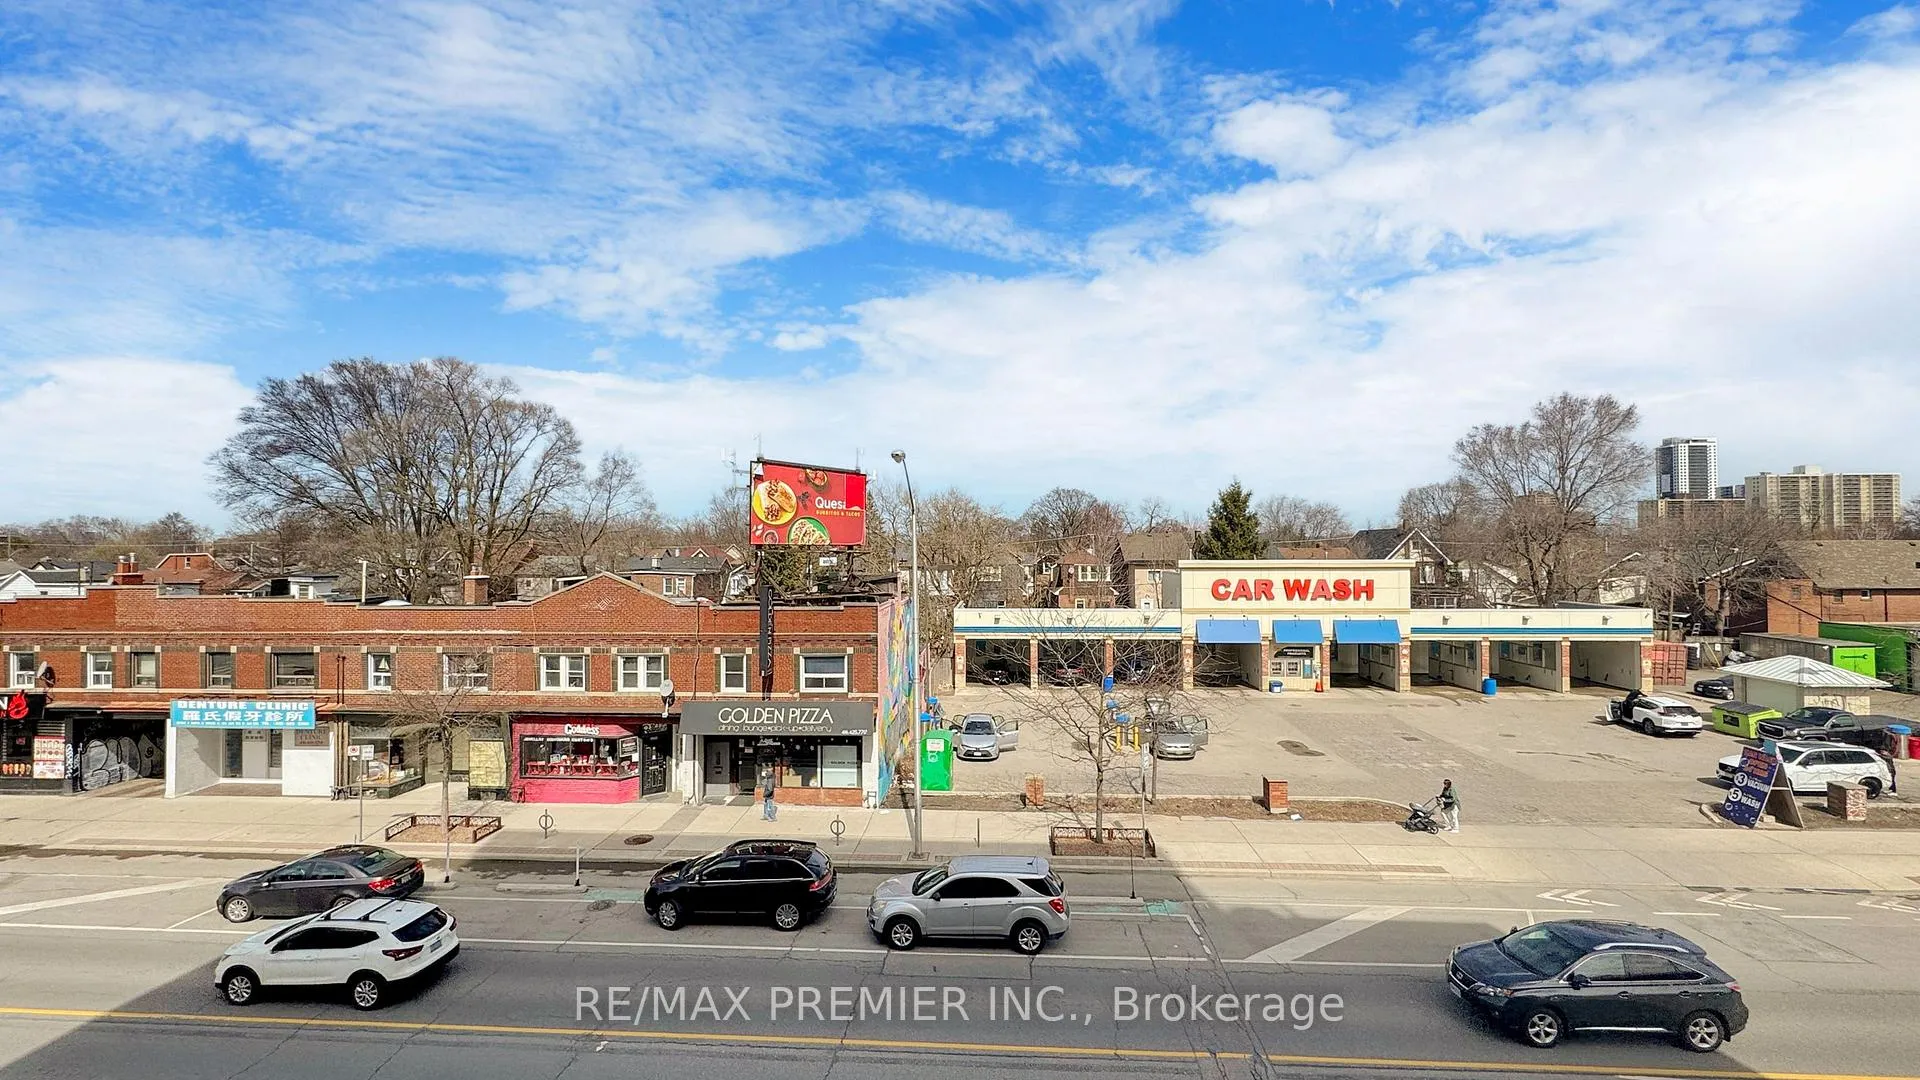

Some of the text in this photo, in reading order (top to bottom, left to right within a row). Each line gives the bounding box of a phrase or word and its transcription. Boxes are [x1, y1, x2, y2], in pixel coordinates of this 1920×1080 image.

[1211, 578, 1375, 602] CAR WASH
[177, 701, 309, 710] DENTURE CLINIC
[718, 707, 834, 724] GOLDEN PIZZA
[718, 725, 739, 733] dining
[1747, 779, 1771, 793] VACUUM
[1741, 795, 1761, 809] WASH
